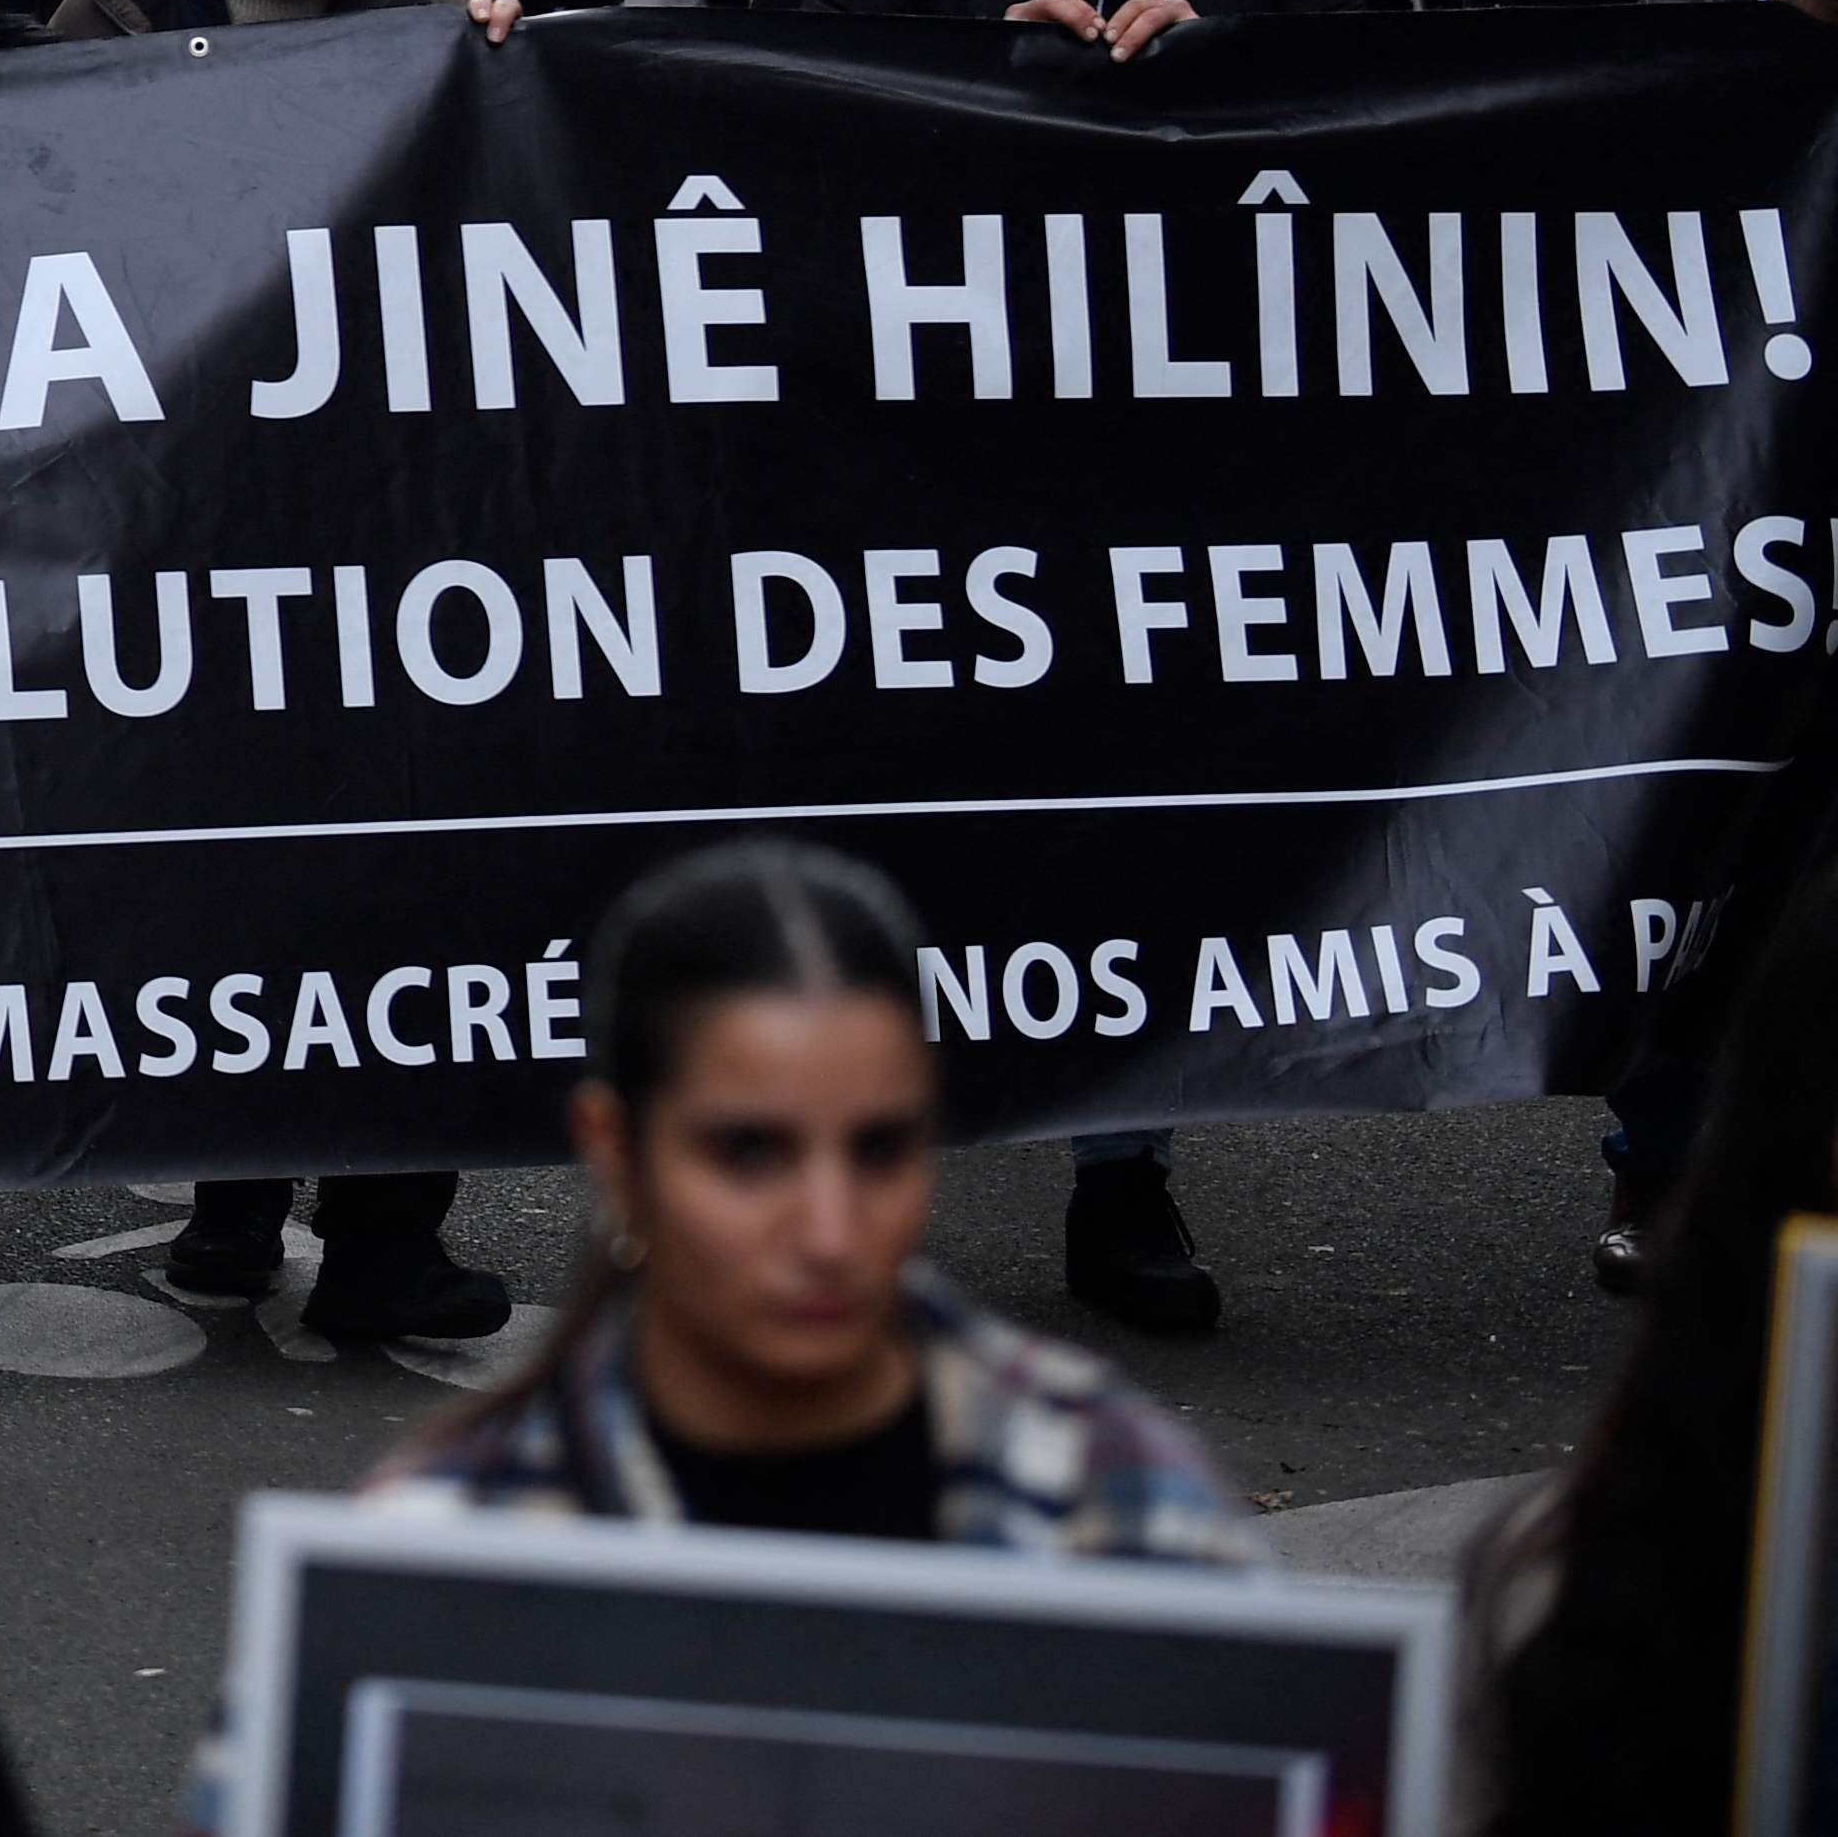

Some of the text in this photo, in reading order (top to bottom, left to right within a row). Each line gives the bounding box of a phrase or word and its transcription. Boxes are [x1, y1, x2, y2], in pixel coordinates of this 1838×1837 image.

[249, 174, 781, 420] JINÊ
[859, 168, 1814, 402] HILÎNIN!
[729, 545, 1056, 695] DES
[914, 938, 1149, 1042] NOS
[1188, 915, 1482, 1033] AMIS
[1521, 886, 1602, 999] À
